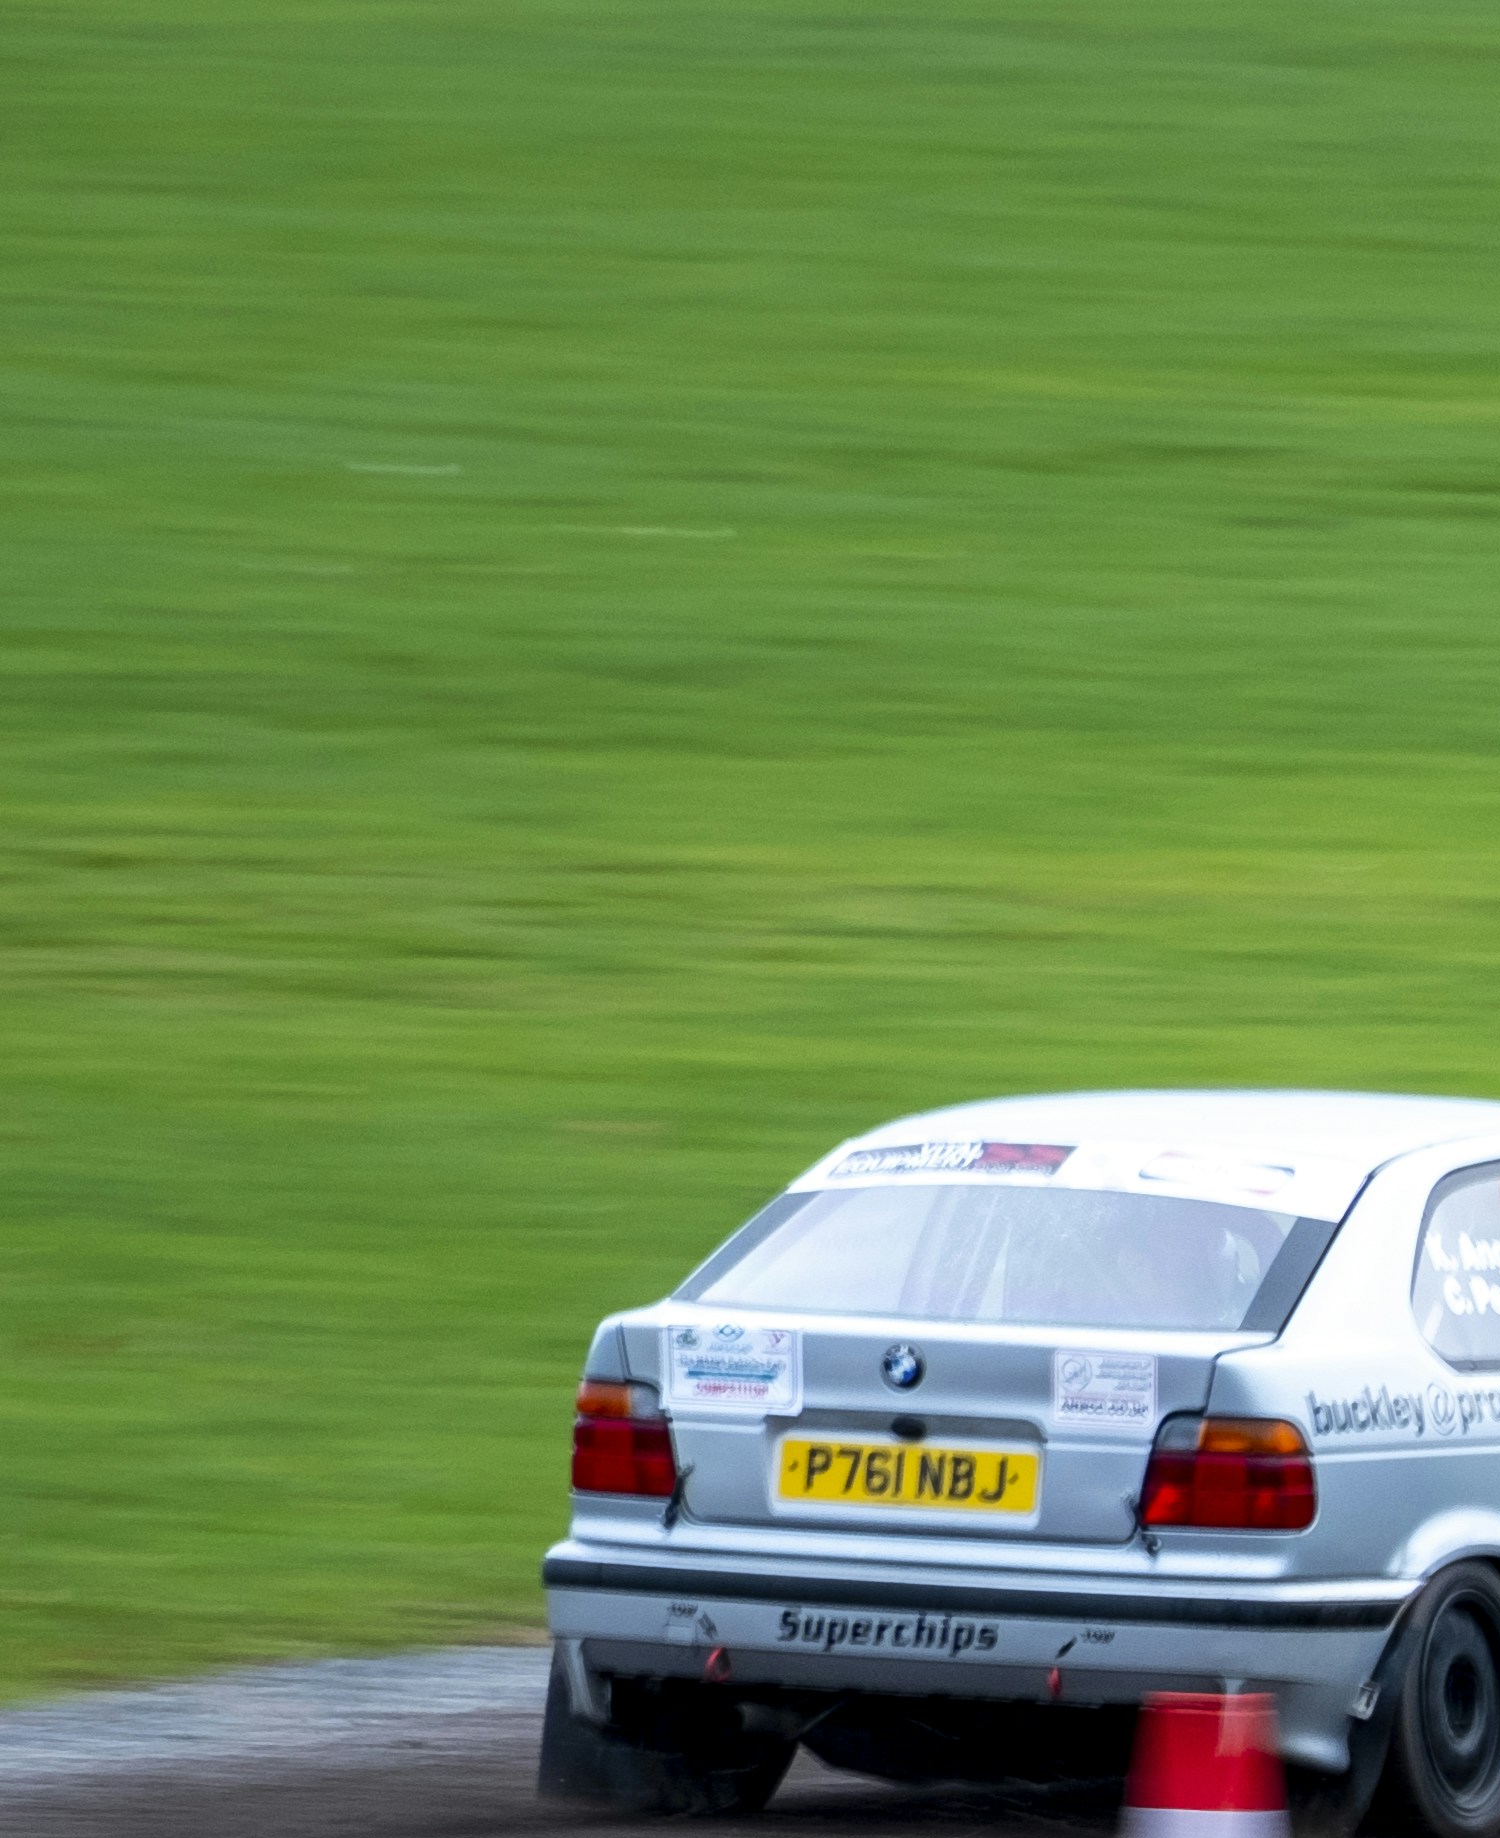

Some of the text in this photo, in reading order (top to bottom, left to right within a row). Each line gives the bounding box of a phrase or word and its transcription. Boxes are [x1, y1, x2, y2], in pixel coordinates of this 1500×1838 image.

[804, 1443, 1009, 1504] P761 NBJ
[776, 1608, 999, 1658] Superchips
